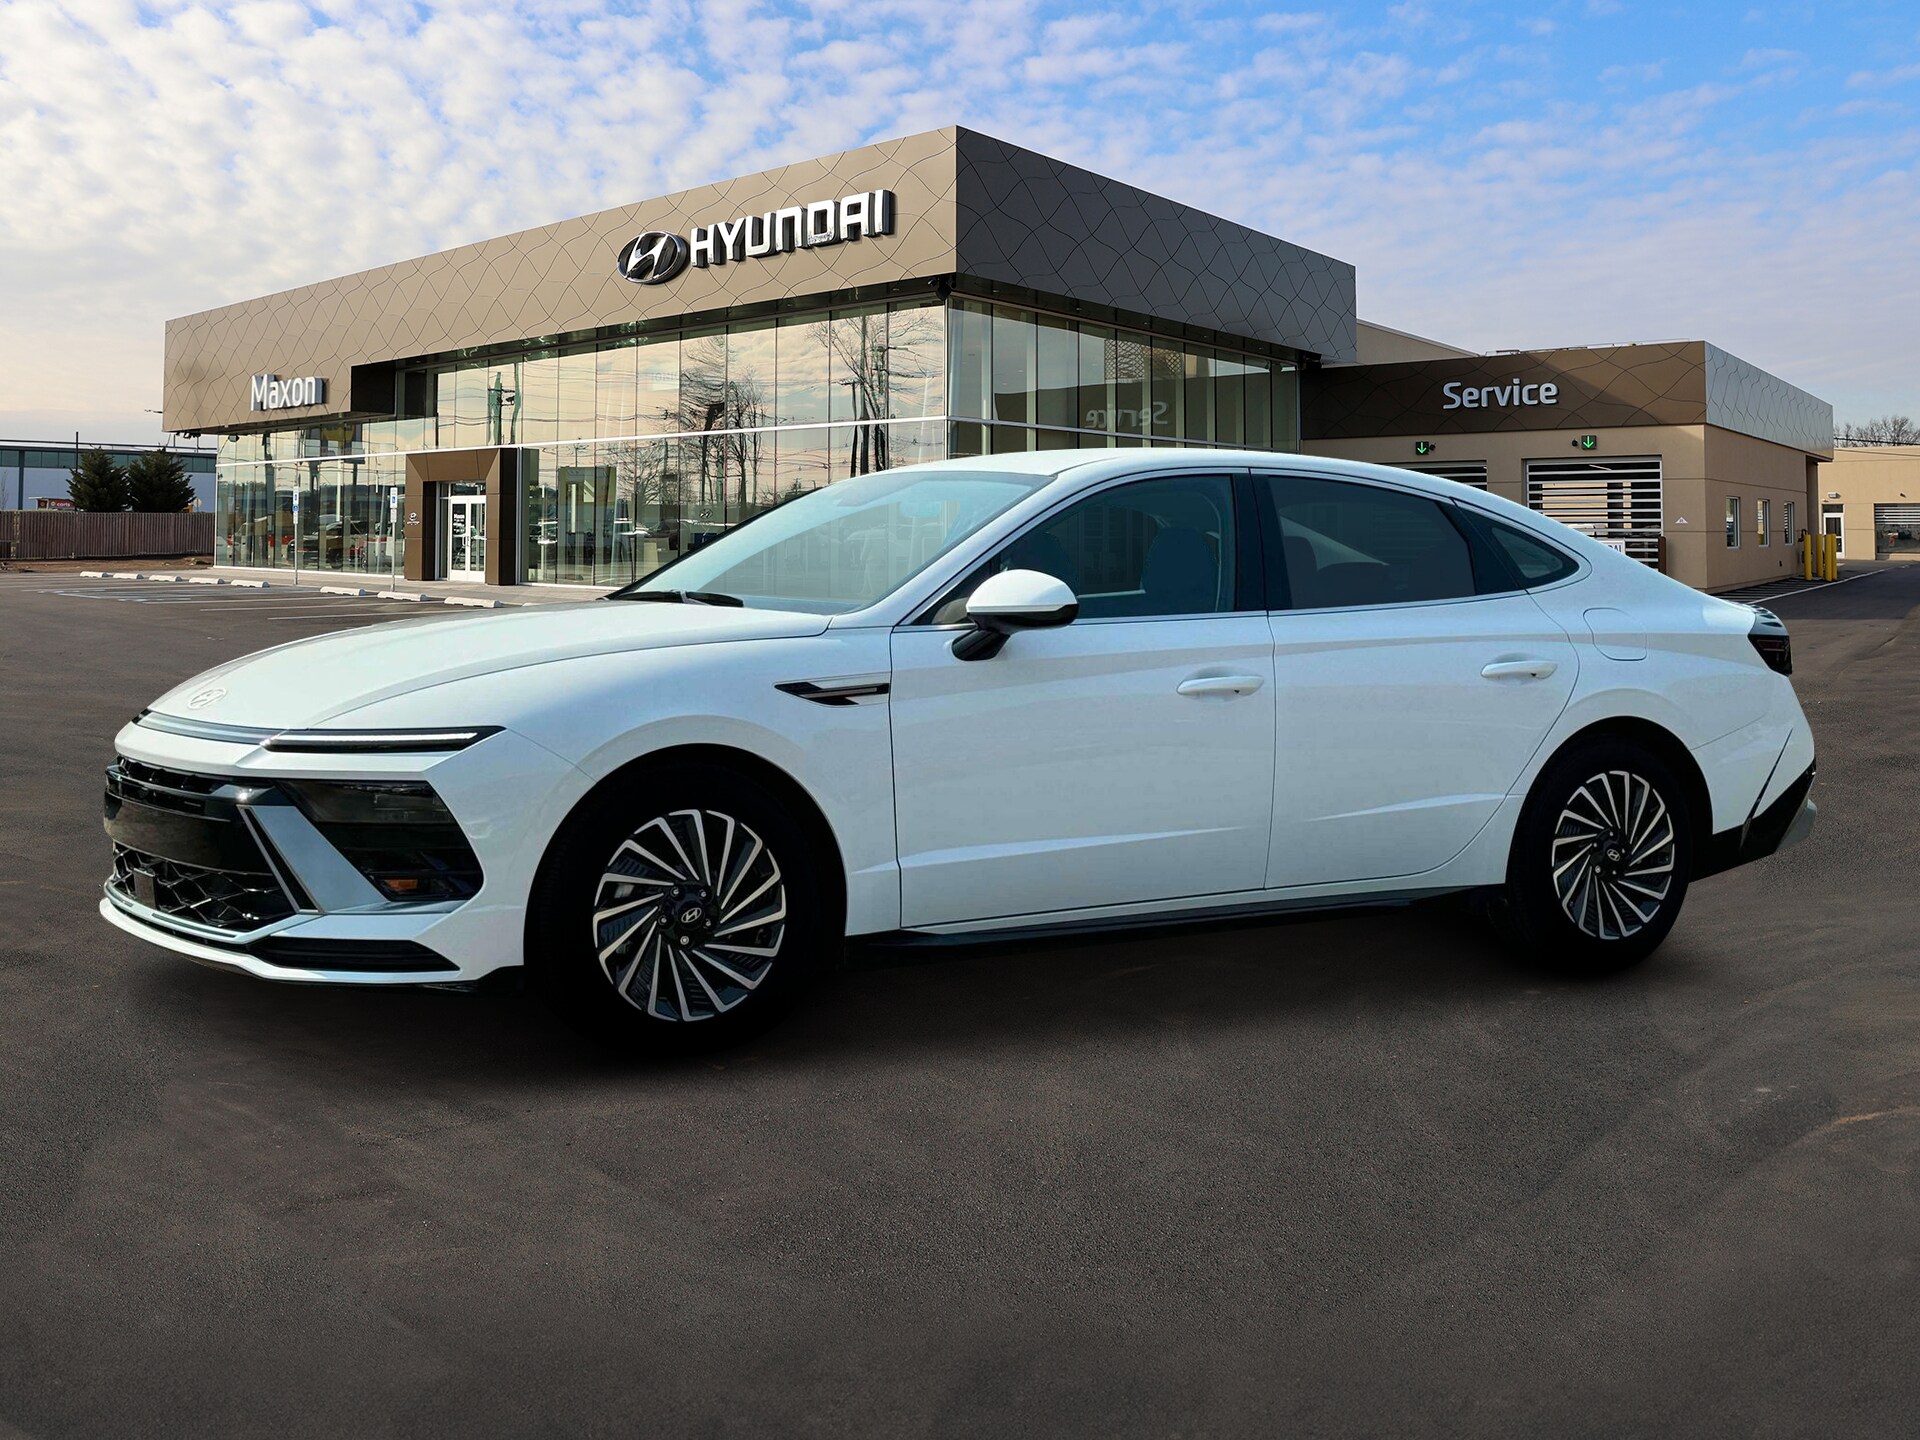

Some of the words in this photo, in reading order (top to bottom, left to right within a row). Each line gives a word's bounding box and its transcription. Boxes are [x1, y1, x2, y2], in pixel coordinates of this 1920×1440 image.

[690, 189, 897, 268] HYUNDAI
[250, 373, 322, 411] Maxon
[1442, 377, 1559, 410] Service
